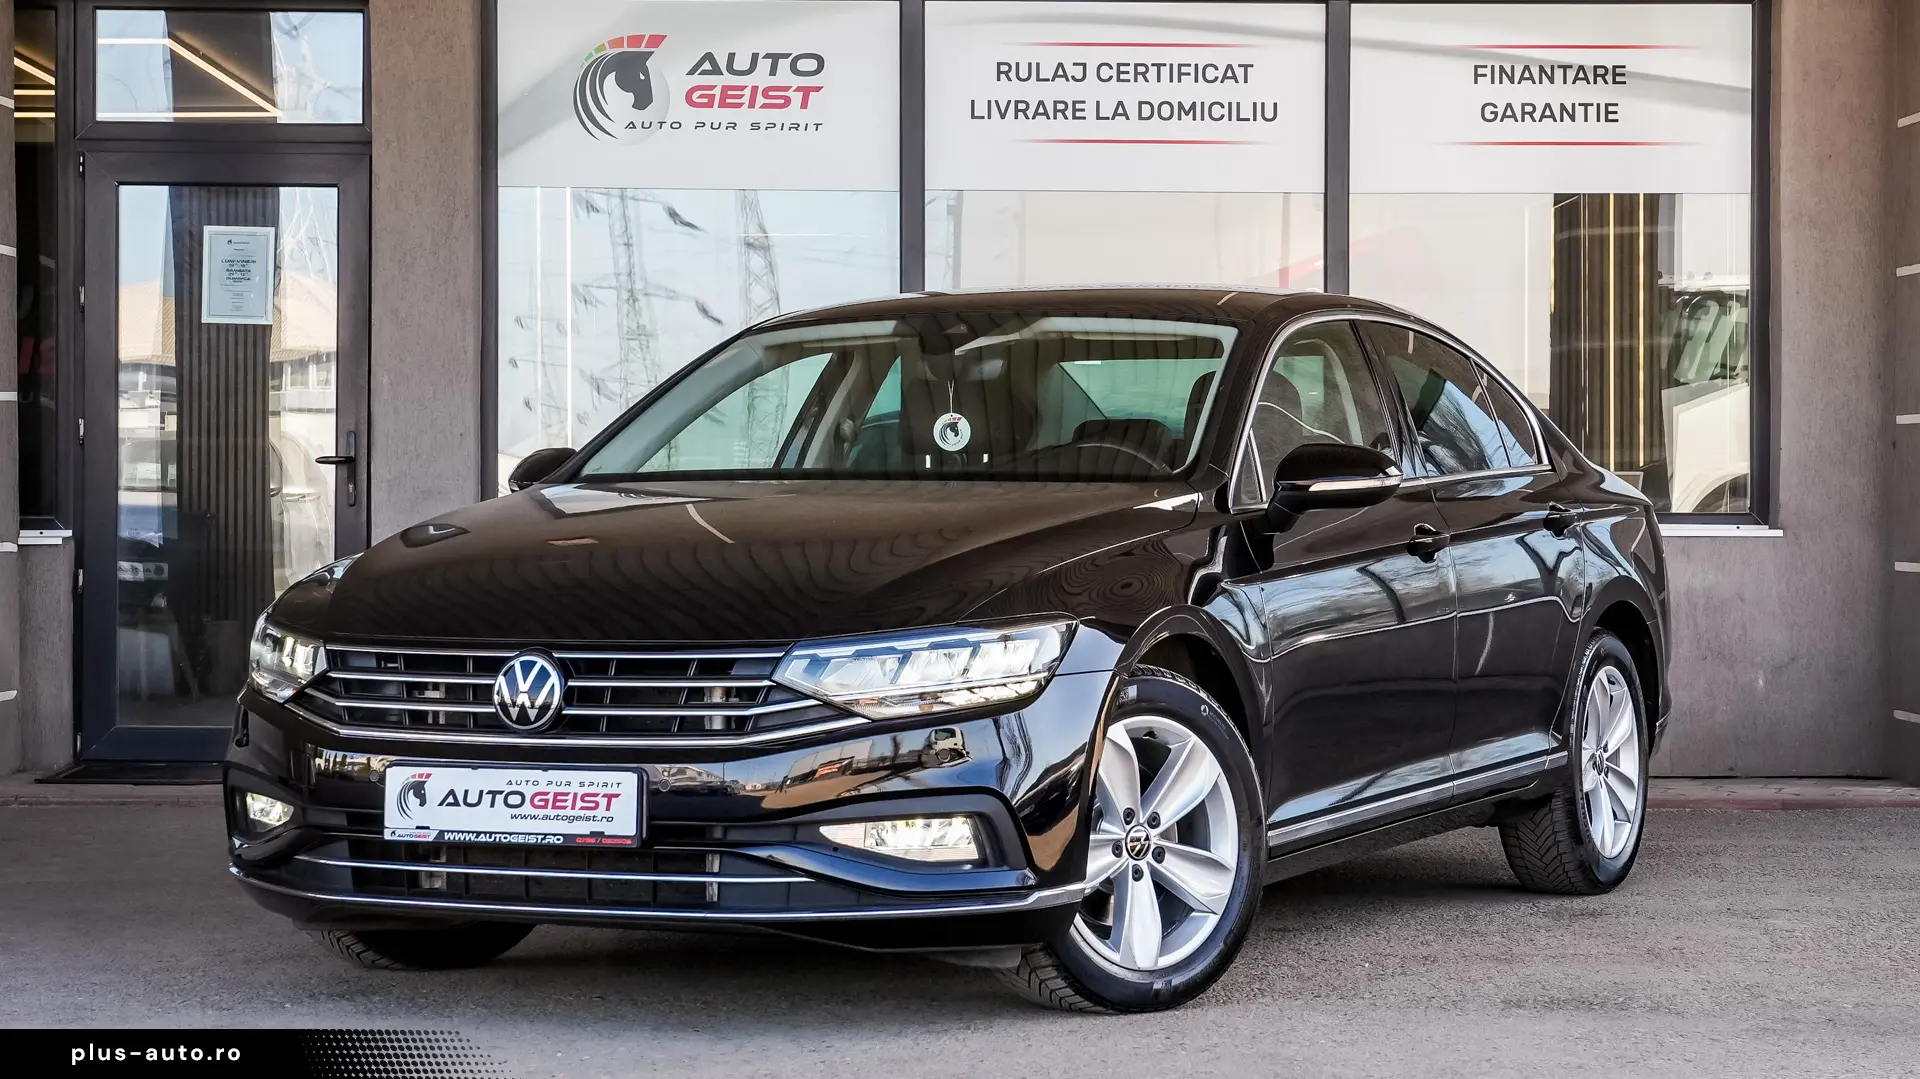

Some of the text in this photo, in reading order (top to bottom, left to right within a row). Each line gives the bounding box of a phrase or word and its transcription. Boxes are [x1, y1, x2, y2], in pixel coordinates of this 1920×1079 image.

[685, 51, 826, 77] AUTO
[996, 61, 1255, 84] RULAJ CERTIFICAT
[1473, 64, 1628, 85] FINANTARE
[684, 84, 825, 110] GEIST
[970, 99, 1279, 123] LIVRARE LA DOMICILIU
[1480, 101, 1621, 123] GARANTIE
[624, 120, 824, 132] AUTO PUR SPIRIT
[546, 780, 572, 788] PUR
[510, 812, 614, 824] www.autogeist.ro
[444, 831, 564, 844] WWW.AUTOGEIST.RO
